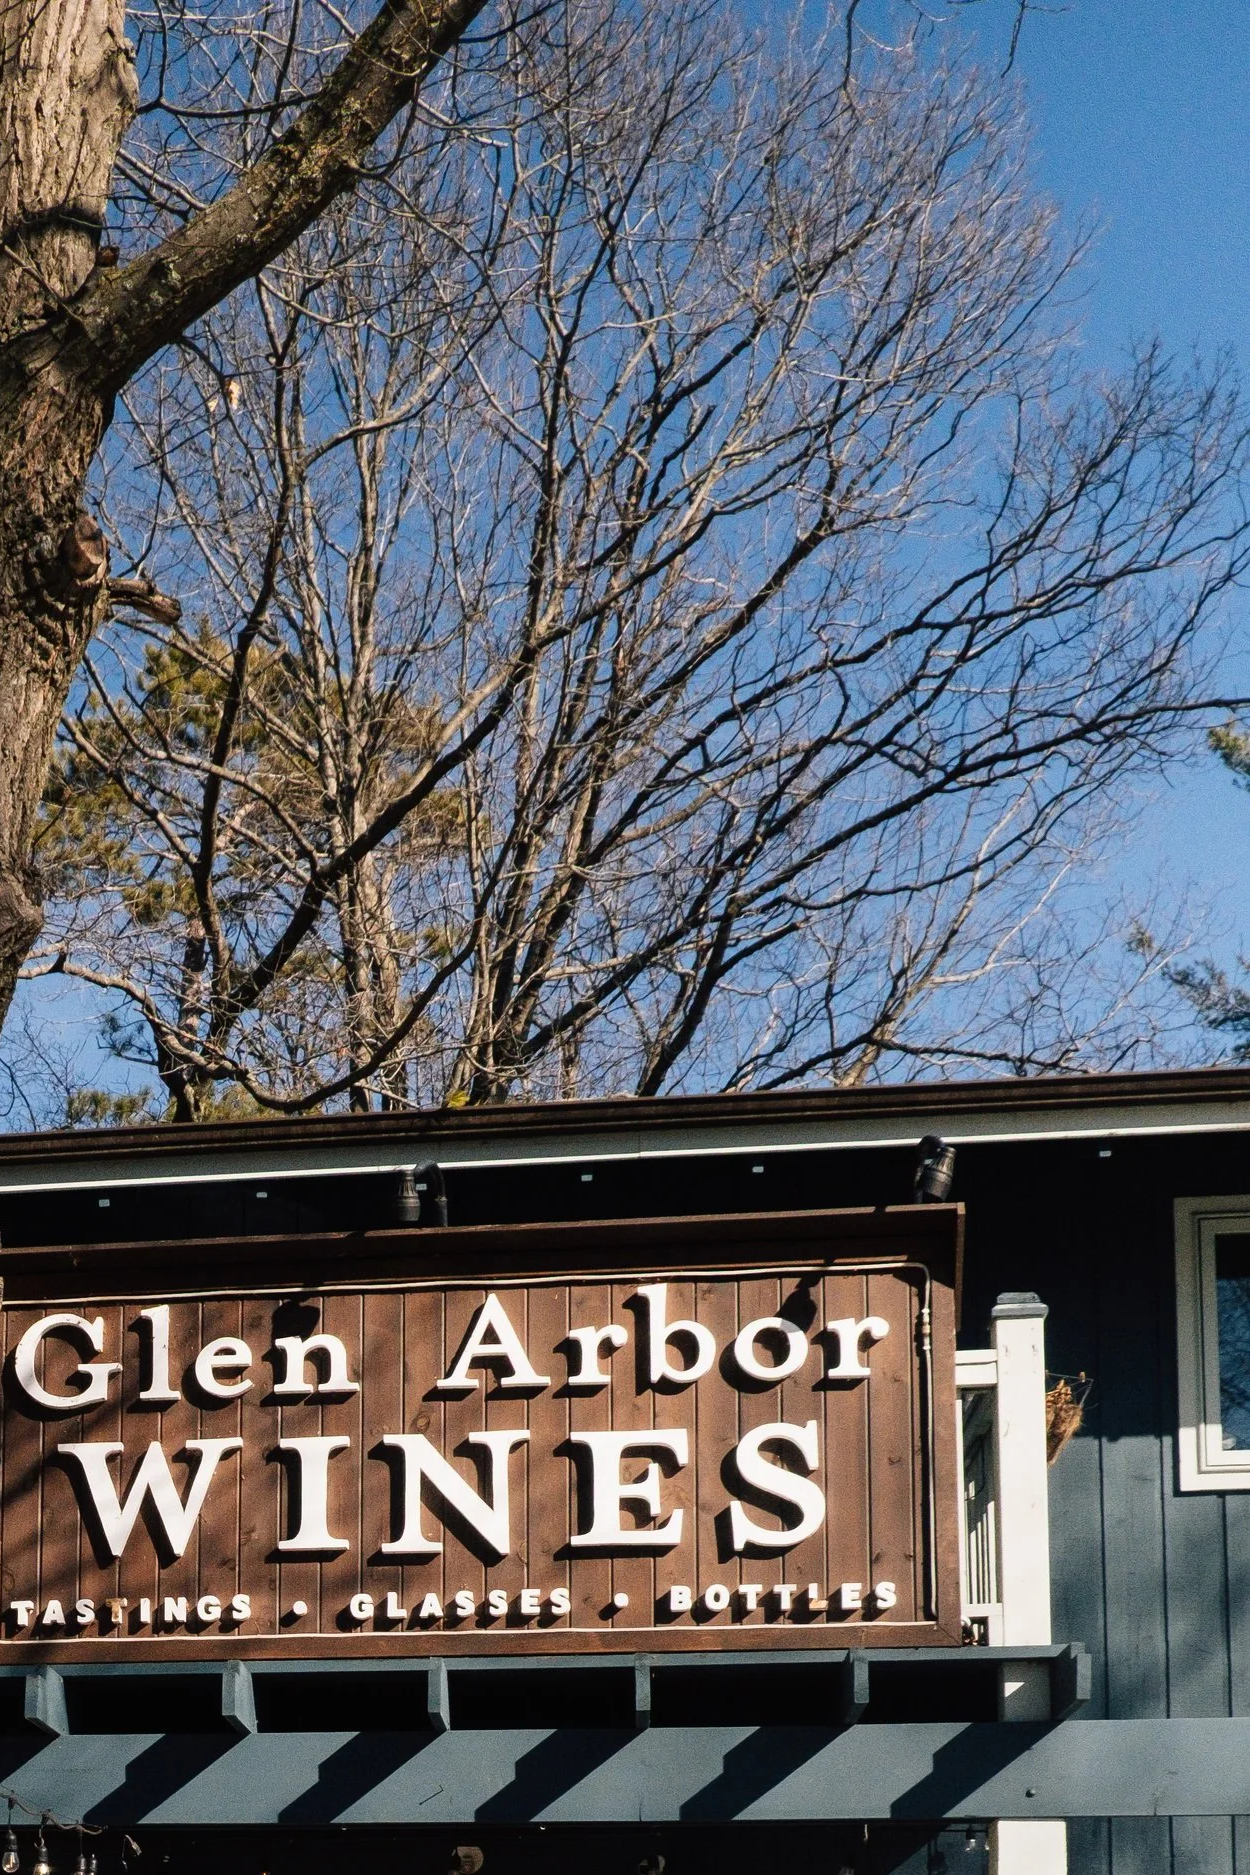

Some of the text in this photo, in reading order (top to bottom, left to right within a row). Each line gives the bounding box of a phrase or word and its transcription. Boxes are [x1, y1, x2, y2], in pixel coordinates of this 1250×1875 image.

[15, 1282, 890, 1410] Glen Arbor
[57, 1419, 827, 1559] WINES
[10, 1581, 897, 1627] TASTINGS GLASSES BOTTLES
